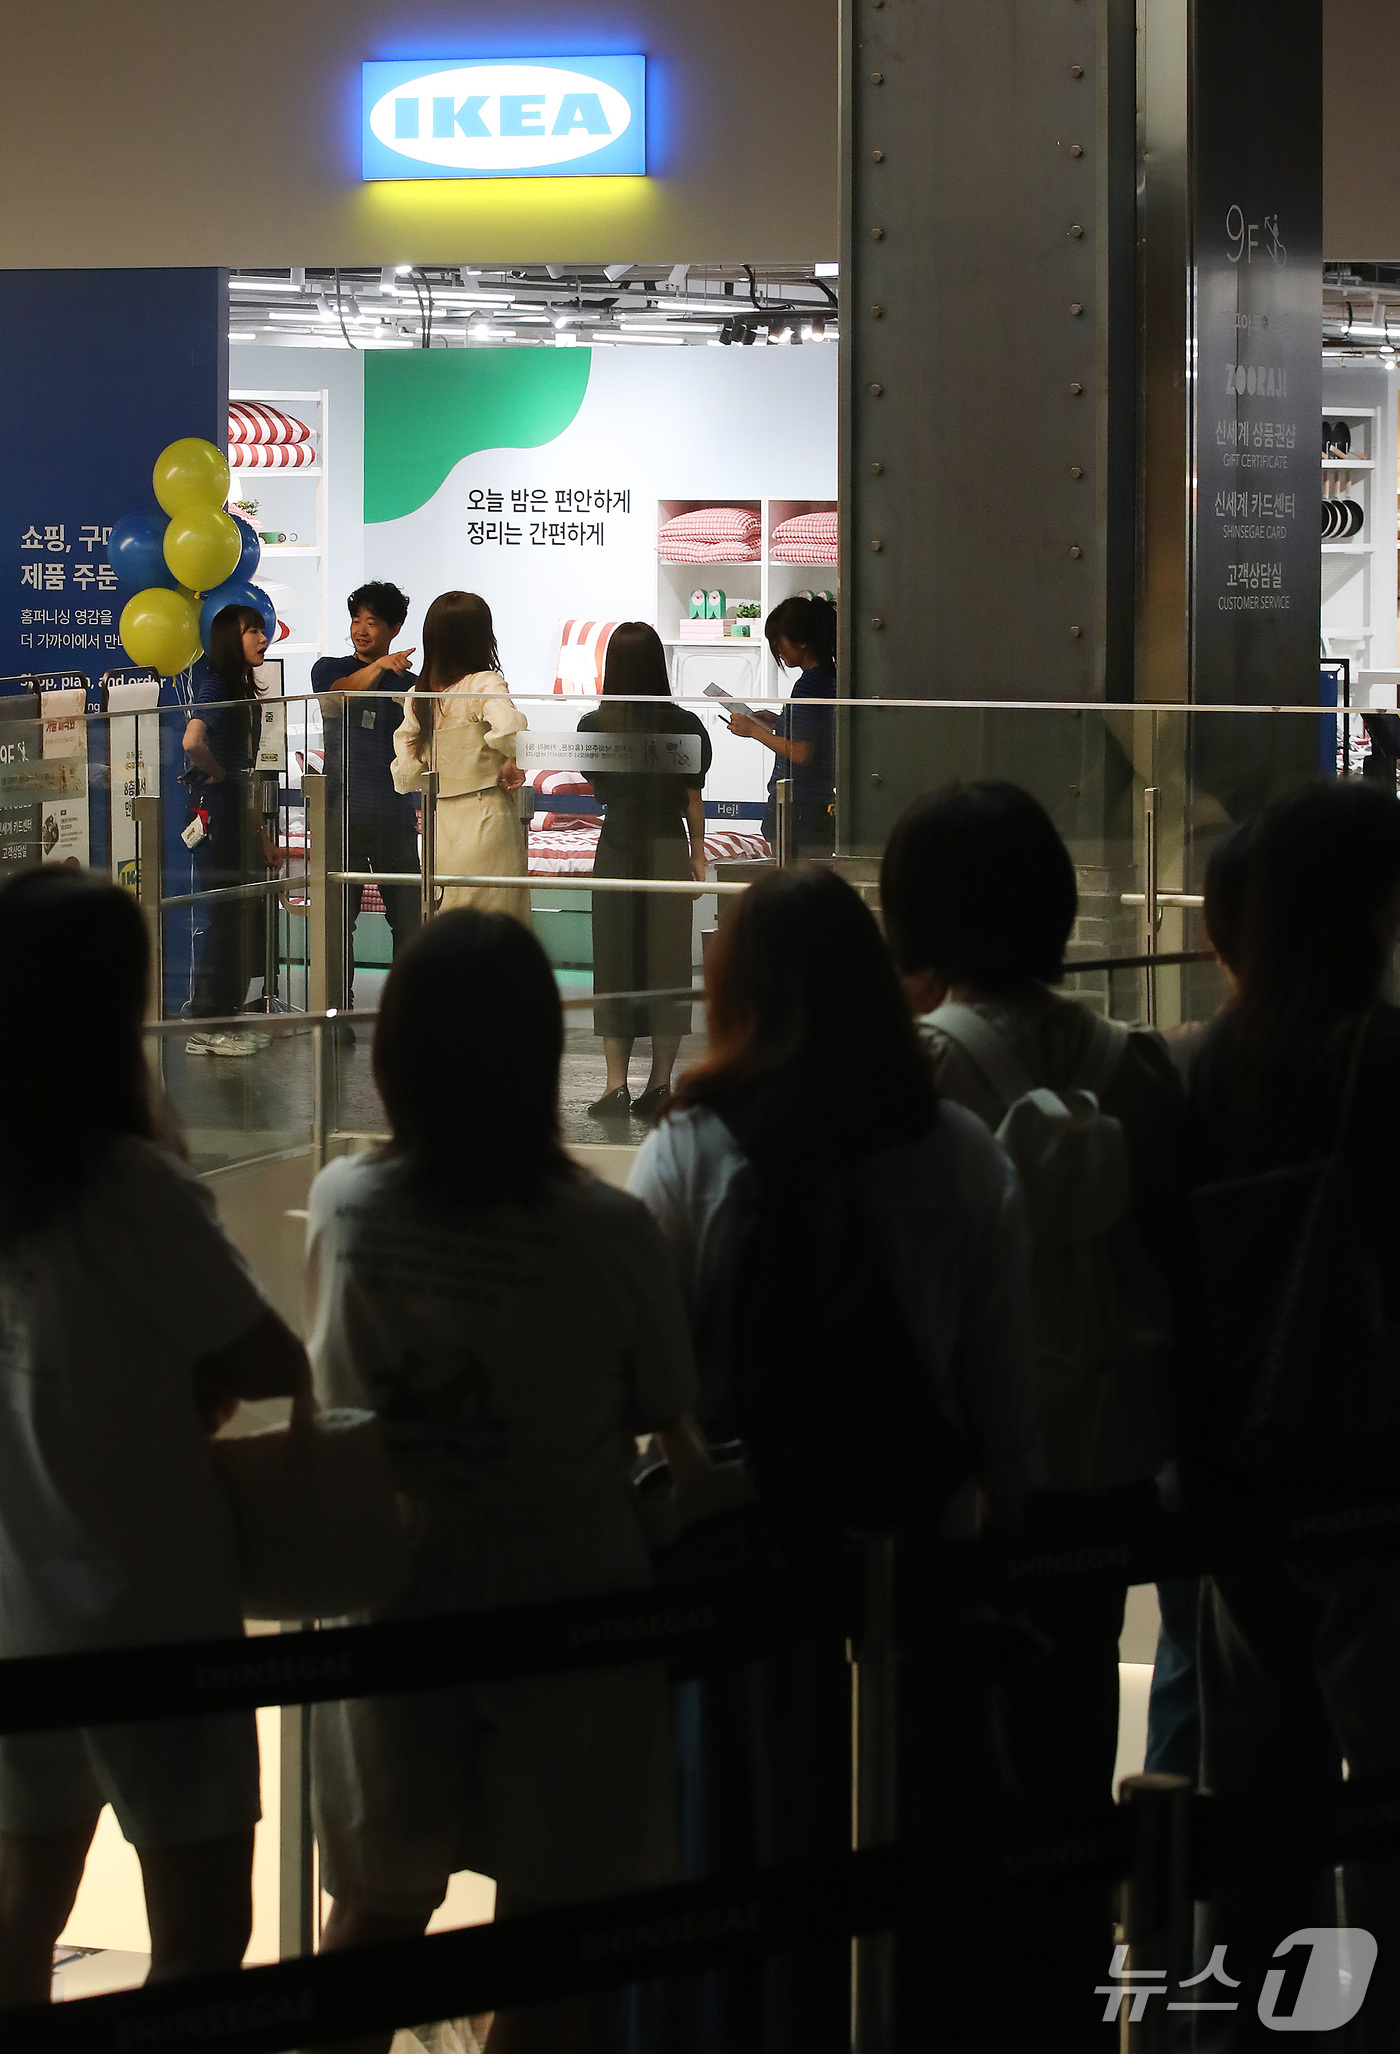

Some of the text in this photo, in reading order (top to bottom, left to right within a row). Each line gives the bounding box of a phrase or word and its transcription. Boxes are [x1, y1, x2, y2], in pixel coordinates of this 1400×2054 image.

[395, 93, 612, 139] IKEA
[1226, 204, 1259, 264] 9F
[1225, 363, 1287, 398] ZOORAJI
[1215, 421, 1296, 449] 신세계 상품권샵
[1223, 453, 1288, 469] GIFT CERTIFICATE
[466, 488, 631, 514] 오늘 밤은 편안하게
[1215, 491, 1296, 519] 신세계 카드센터
[20, 524, 72, 553] 쇼핑,
[466, 522, 605, 547] 정리는 간편하게
[1223, 525, 1287, 539] SHINSEGAE CARD
[20, 563, 66, 591] 제품
[1227, 562, 1282, 589] 고객상담실
[20, 609, 113, 625] 홈퍼니싱 영감을
[1218, 596, 1290, 611] CUSTOMER SERVICE
[20, 633, 33, 649] 더
[37, 633, 100, 649] 가까이에서
[717, 803, 739, 817] Hej!
[1008, 1545, 1131, 1580] SHINSEGAE
[566, 1605, 717, 1647] SHINSEGAE
[193, 1650, 354, 1692] SHINSEGAE
[579, 1900, 761, 1963] SHINSEGAE
